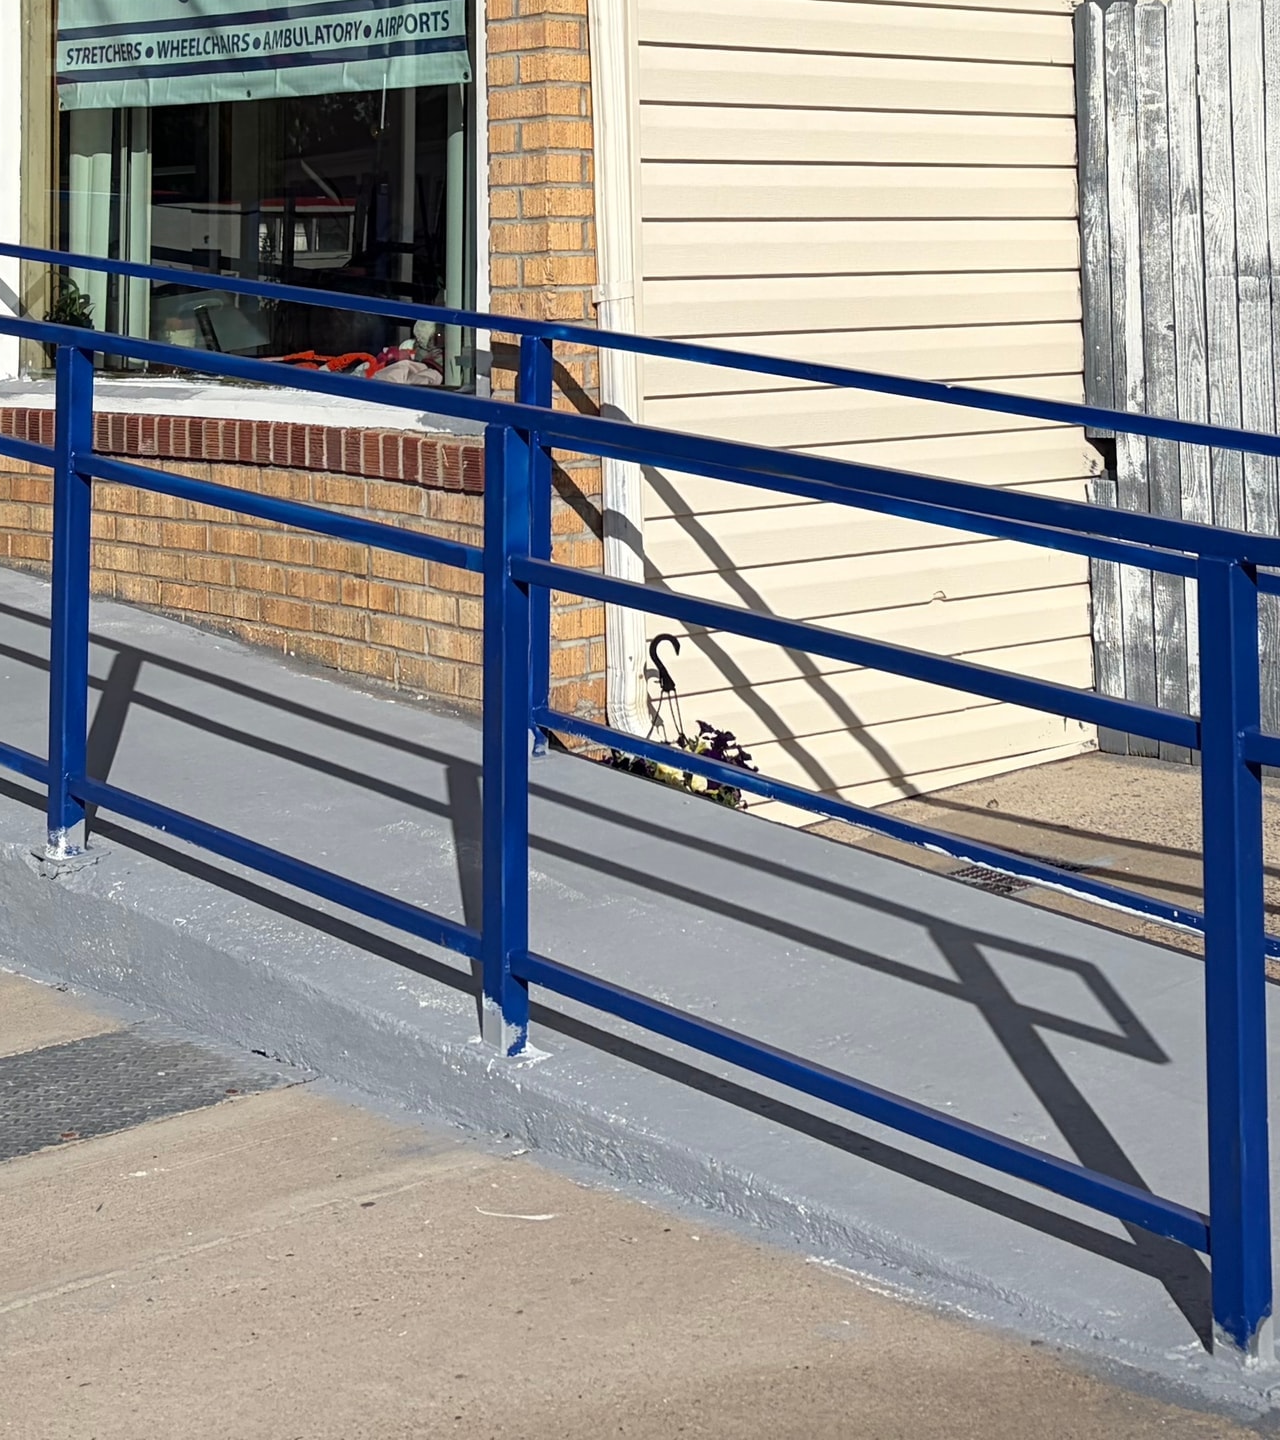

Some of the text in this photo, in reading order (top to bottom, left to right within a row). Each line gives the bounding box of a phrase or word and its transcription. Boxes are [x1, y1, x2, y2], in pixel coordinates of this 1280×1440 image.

[66, 9, 450, 66] STRETCHERS WHEELCHAIRS AMBULATORY AIRPORTS
